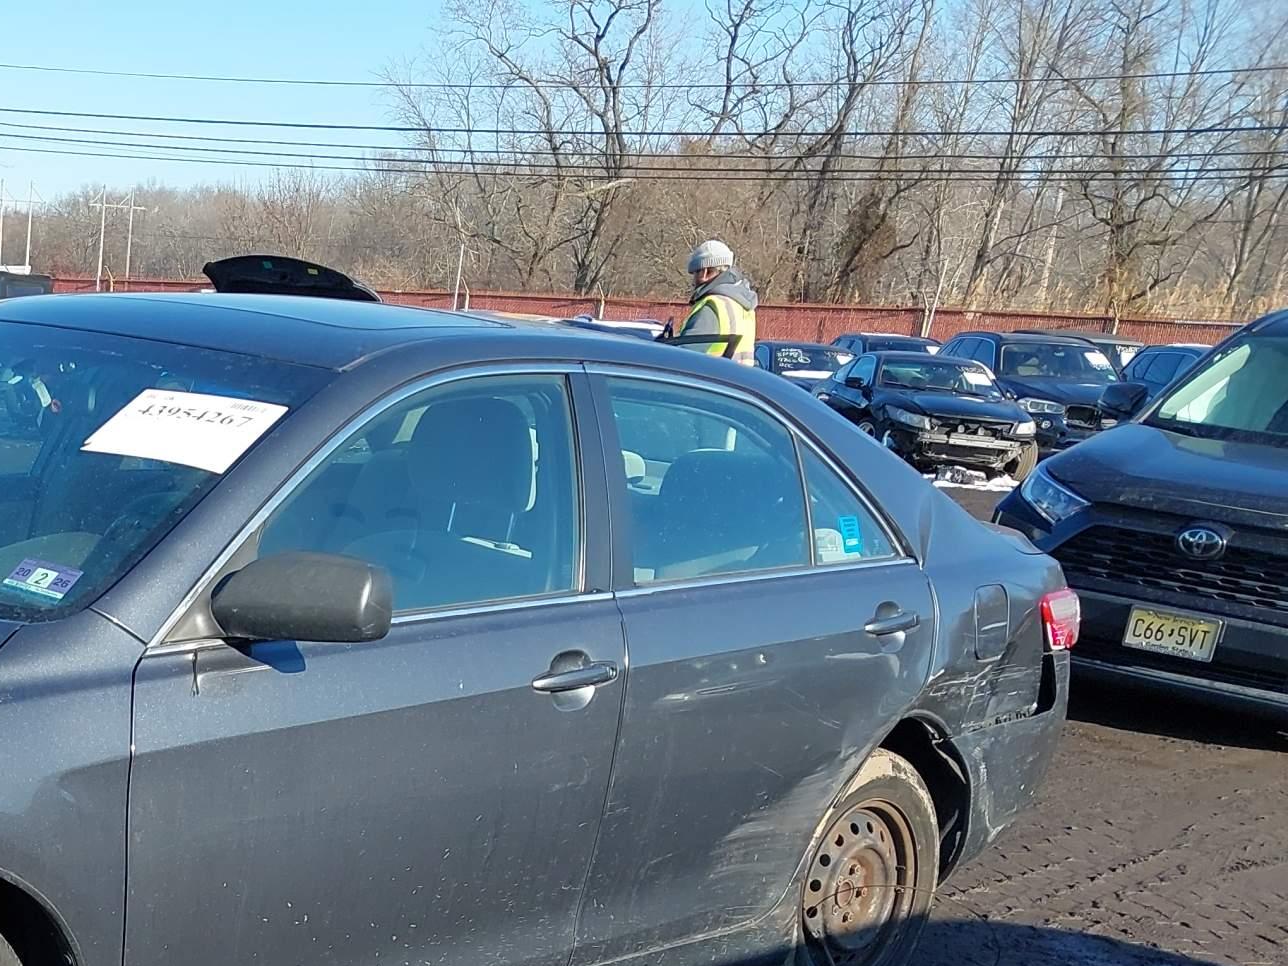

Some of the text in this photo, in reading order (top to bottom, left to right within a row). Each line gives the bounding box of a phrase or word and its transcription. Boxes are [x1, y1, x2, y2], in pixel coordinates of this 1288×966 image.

[138, 404, 255, 429] 43954267
[16, 567, 32, 577] 20
[33, 572, 49, 585] 2
[53, 577, 71, 588] 26
[1132, 618, 1211, 650] C66 SVT
